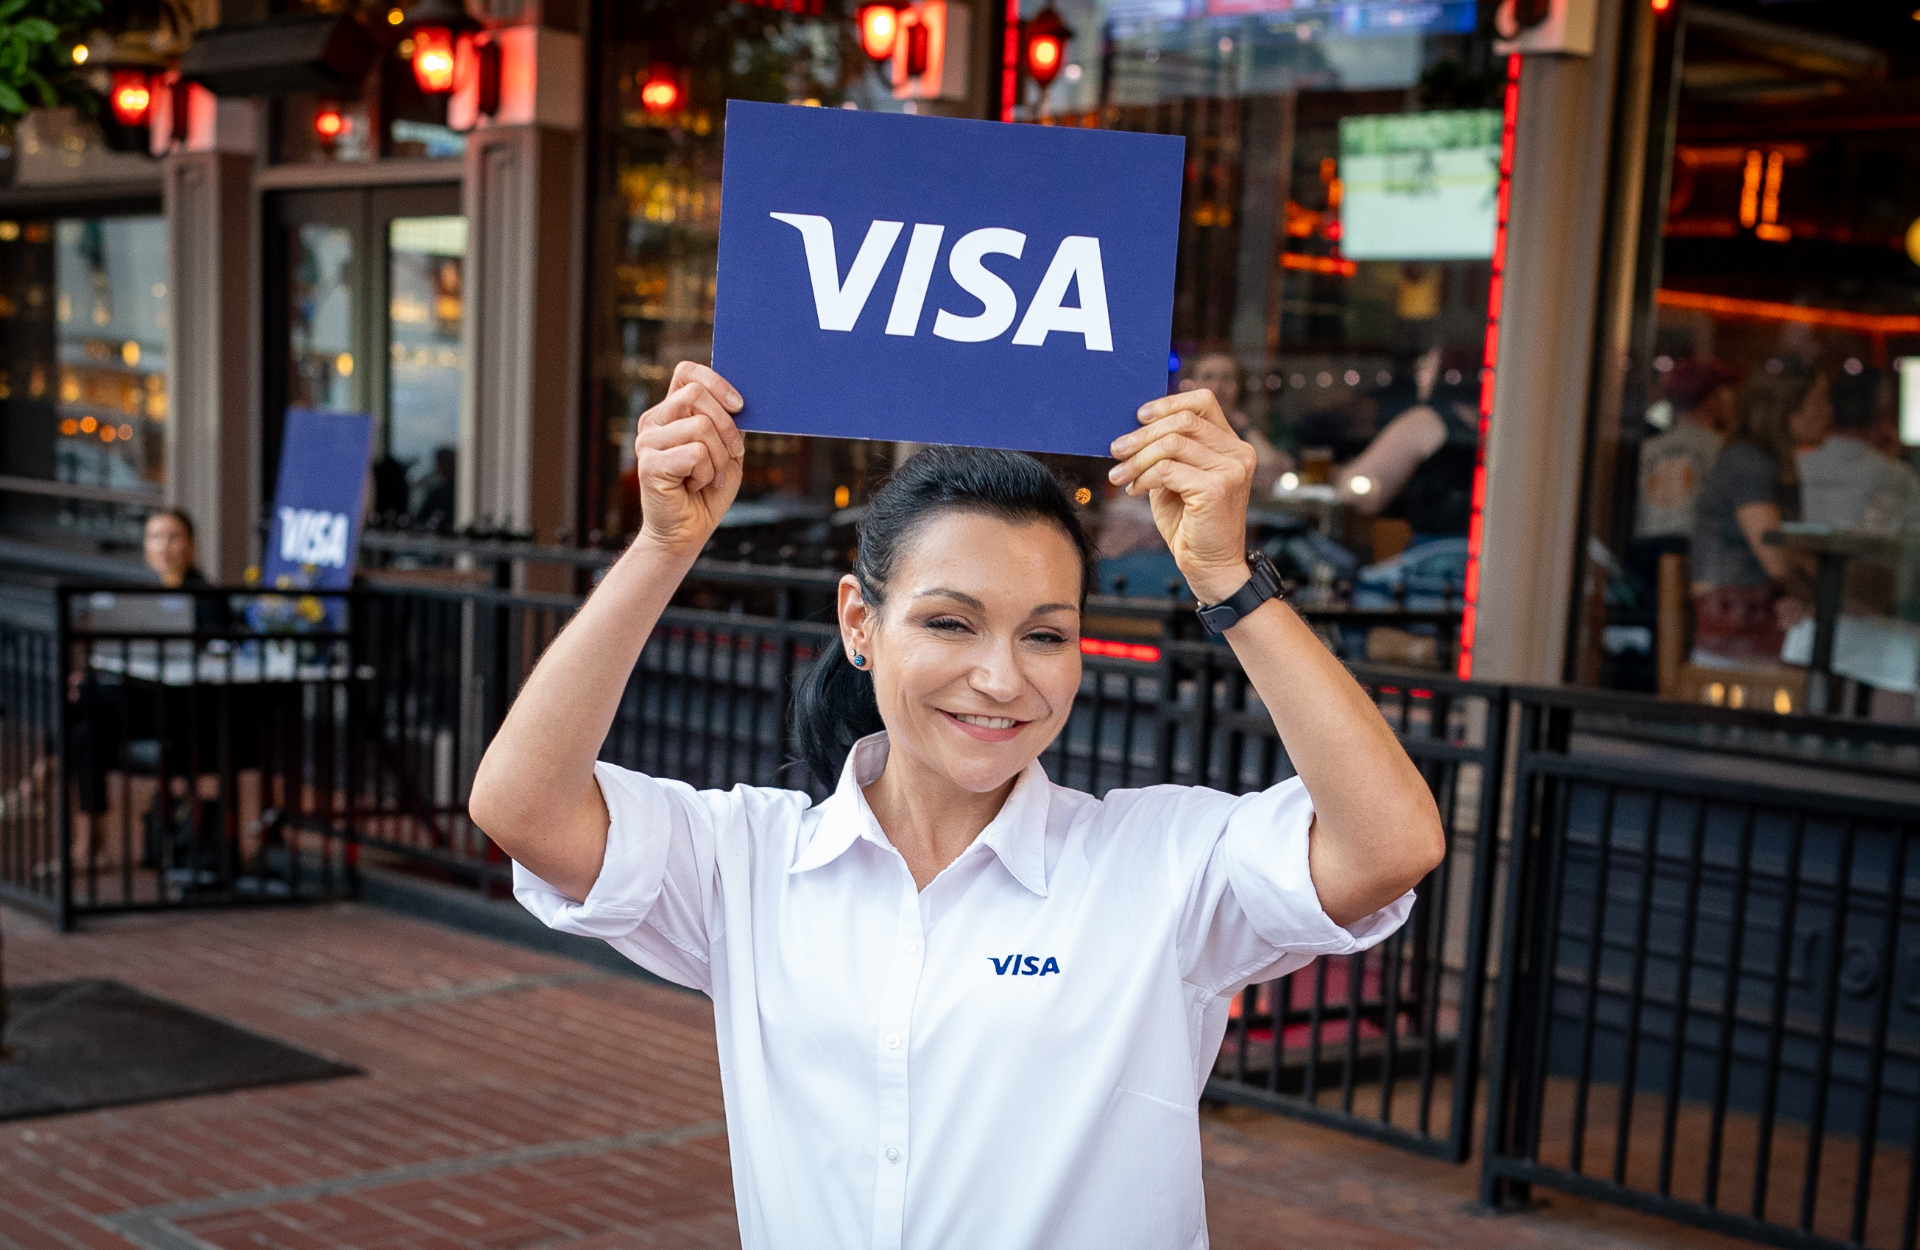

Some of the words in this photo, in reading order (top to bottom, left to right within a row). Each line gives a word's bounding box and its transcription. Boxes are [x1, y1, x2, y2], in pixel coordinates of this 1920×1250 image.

[769, 211, 1114, 352] VISA
[279, 507, 349, 568] VISA
[987, 954, 1060, 977] VISA
